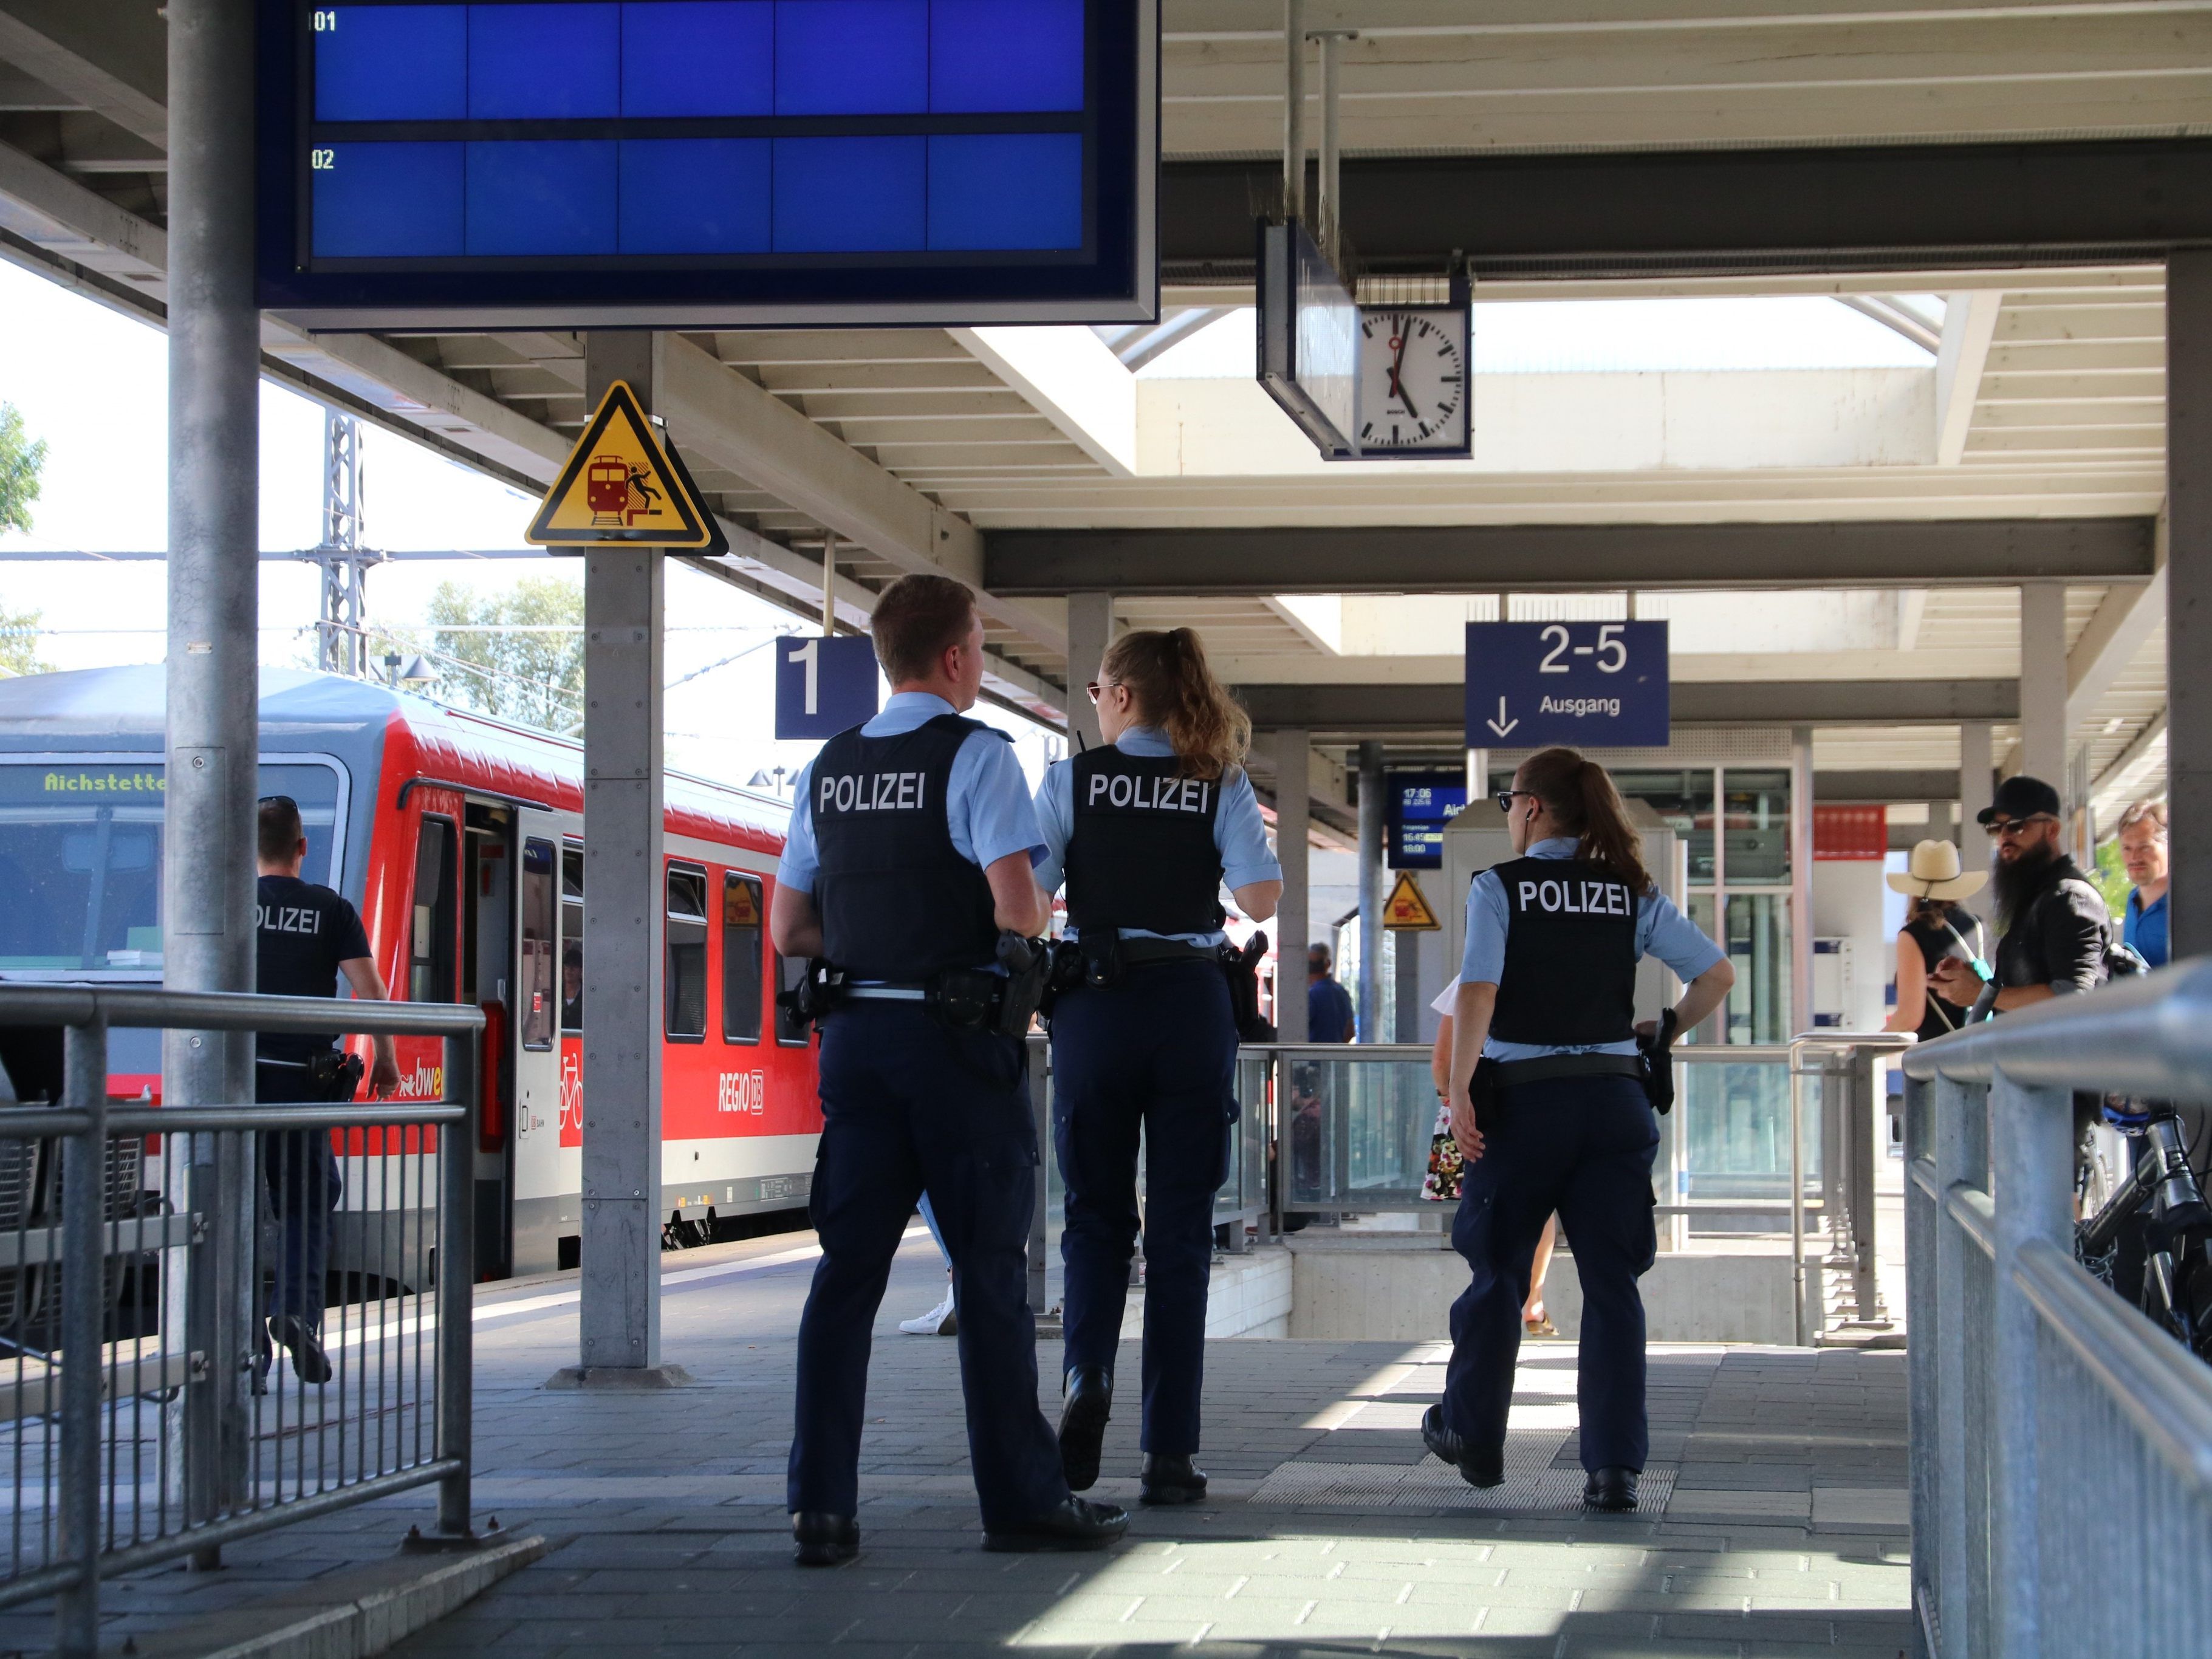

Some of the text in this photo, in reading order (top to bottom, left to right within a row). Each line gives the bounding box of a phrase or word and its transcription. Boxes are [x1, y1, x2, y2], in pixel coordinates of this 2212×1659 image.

[315, 11, 335, 31] 01
[312, 149, 334, 169] 02
[1539, 624, 1627, 673] 2-5
[789, 640, 818, 714] 1
[1539, 695, 1620, 717] Ausgang
[820, 772, 925, 813] POLIZEI
[1089, 774, 1208, 813] POLIZEI
[1519, 880, 1631, 915] POLIZEI
[416, 1056, 443, 1096] bwe
[718, 1072, 750, 1112] REGIO
